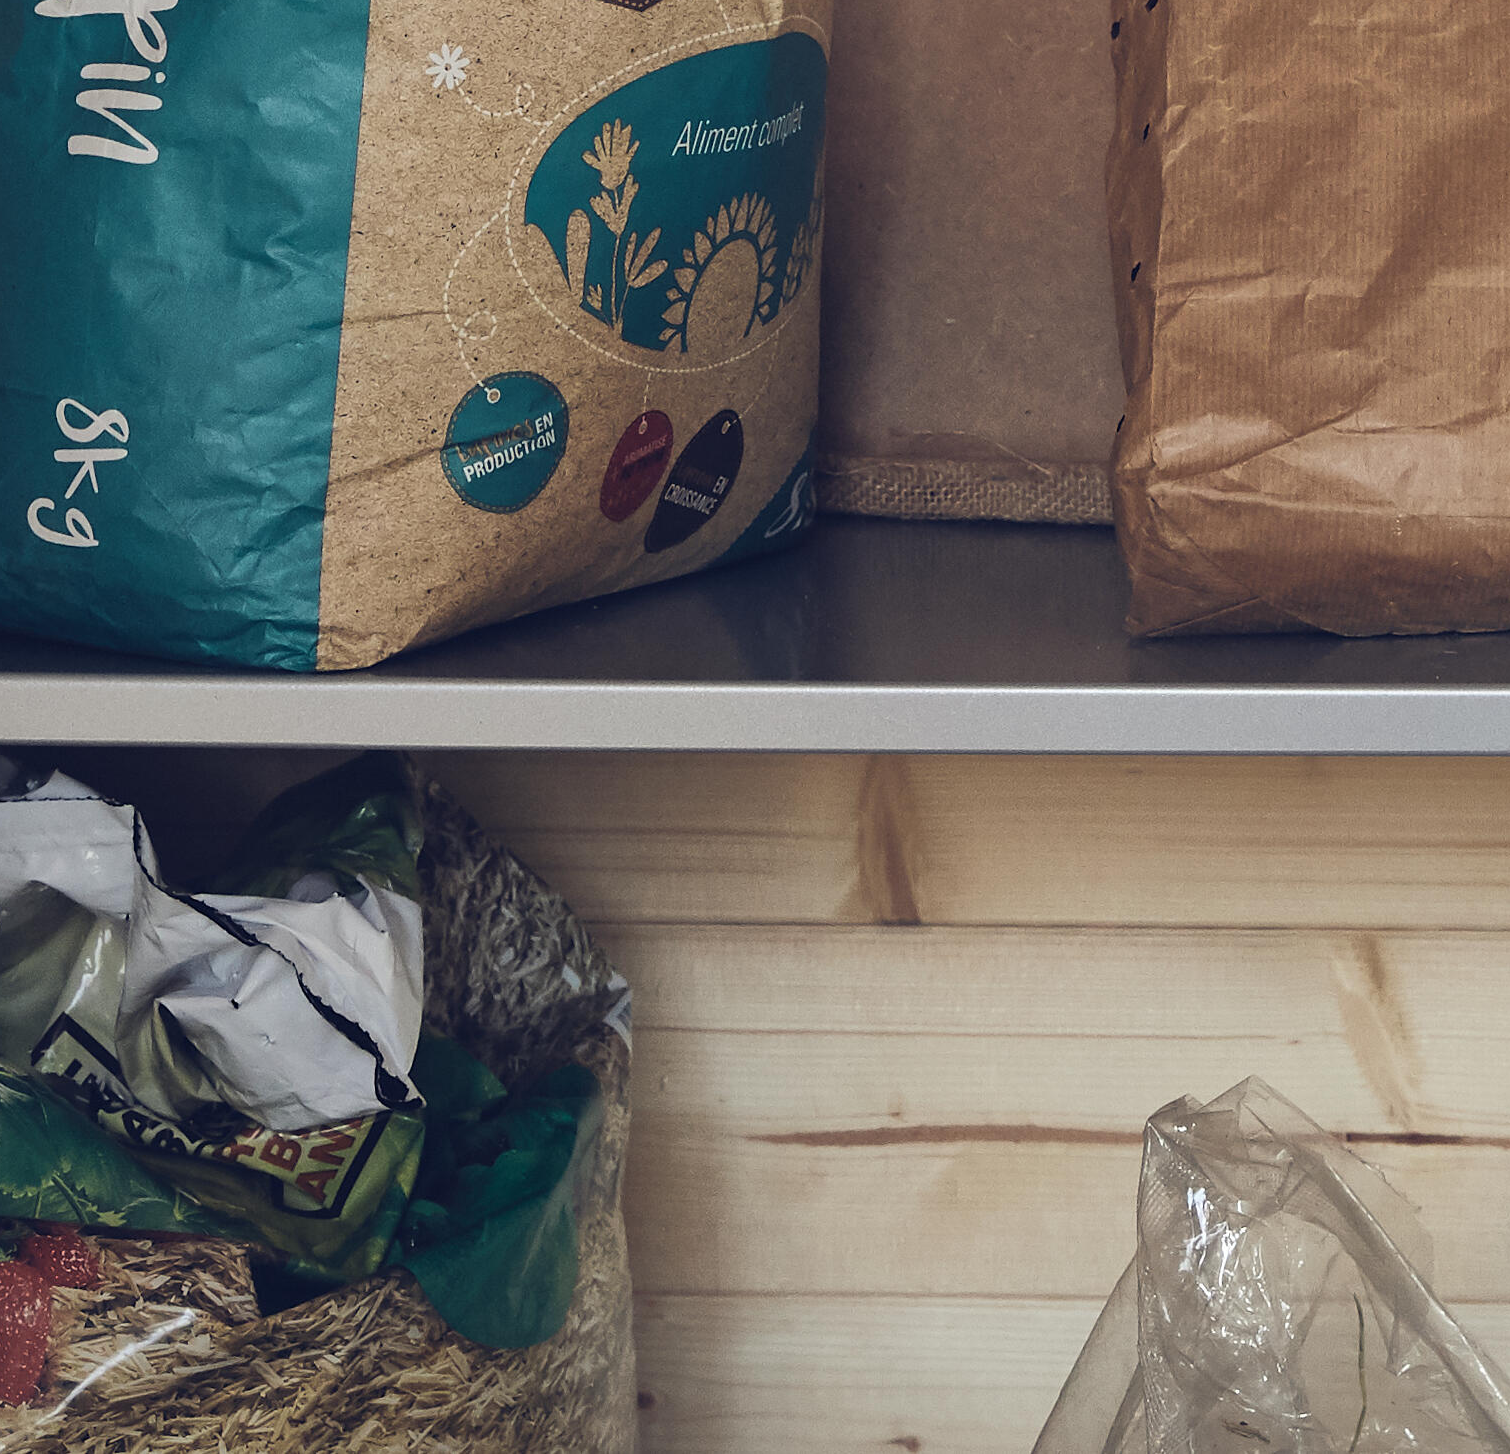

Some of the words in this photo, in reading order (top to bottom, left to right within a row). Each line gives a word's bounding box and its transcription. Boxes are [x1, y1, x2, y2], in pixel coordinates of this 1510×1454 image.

[672, 119, 757, 156] Aliment
[758, 100, 804, 147] complet
[535, 412, 553, 434] EN
[28, 397, 130, 547] 8kg
[463, 428, 556, 483] PRODUCTION
[663, 483, 719, 515] CROISSANCE
